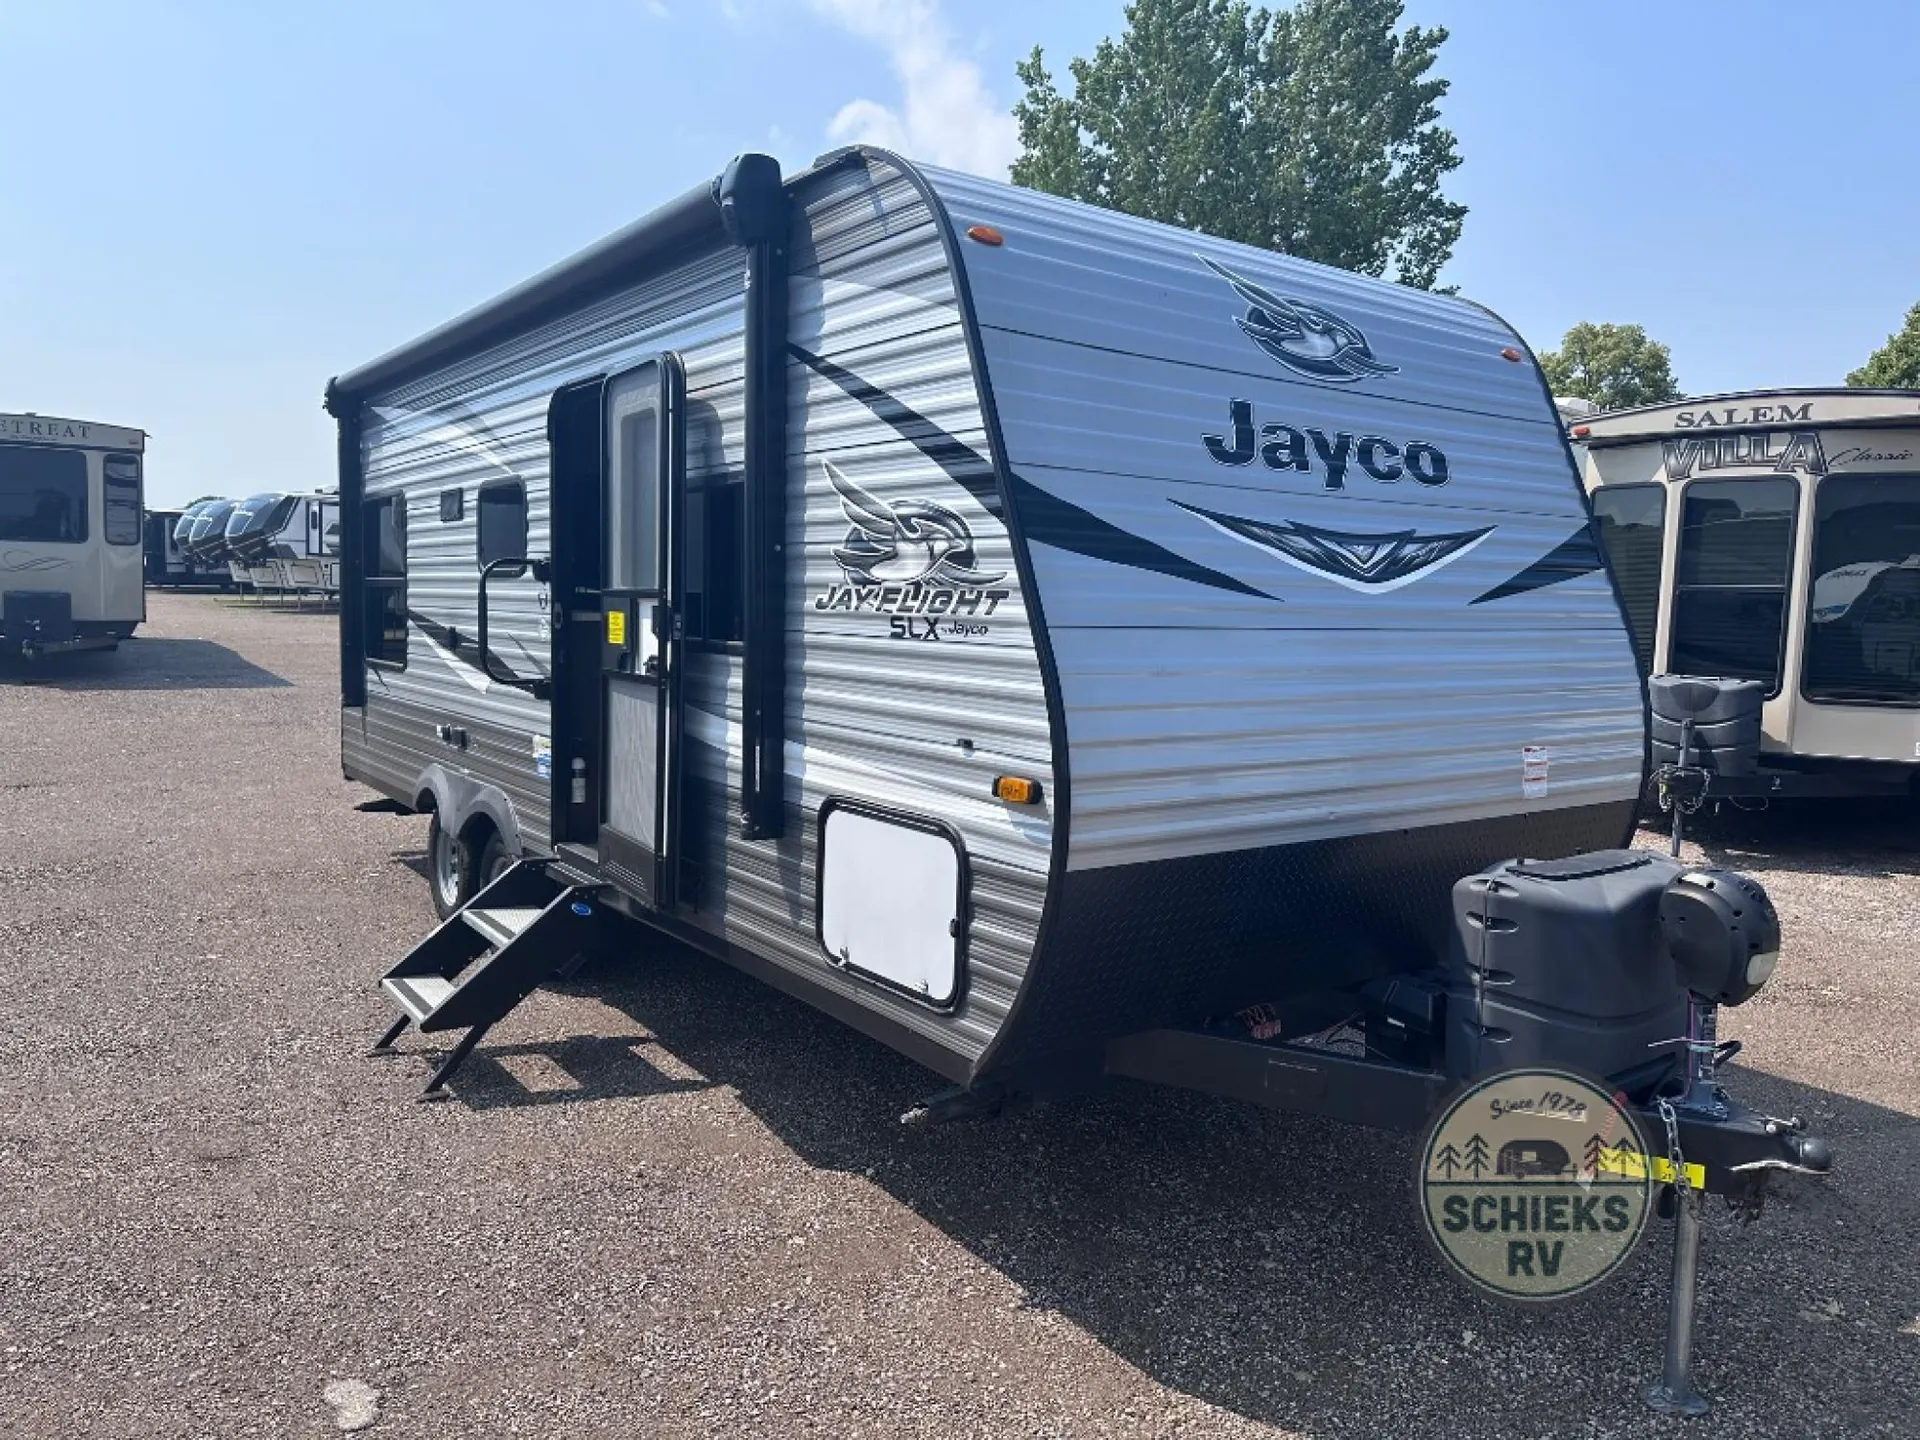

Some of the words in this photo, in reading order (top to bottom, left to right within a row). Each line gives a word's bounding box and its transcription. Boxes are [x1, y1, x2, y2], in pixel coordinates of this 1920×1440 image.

[1674, 403, 1813, 428] SALEM
[1201, 397, 1451, 491] Jayco
[1661, 431, 1828, 482] VILLA
[889, 615, 941, 641] SLX
[948, 620, 989, 637] Jayco
